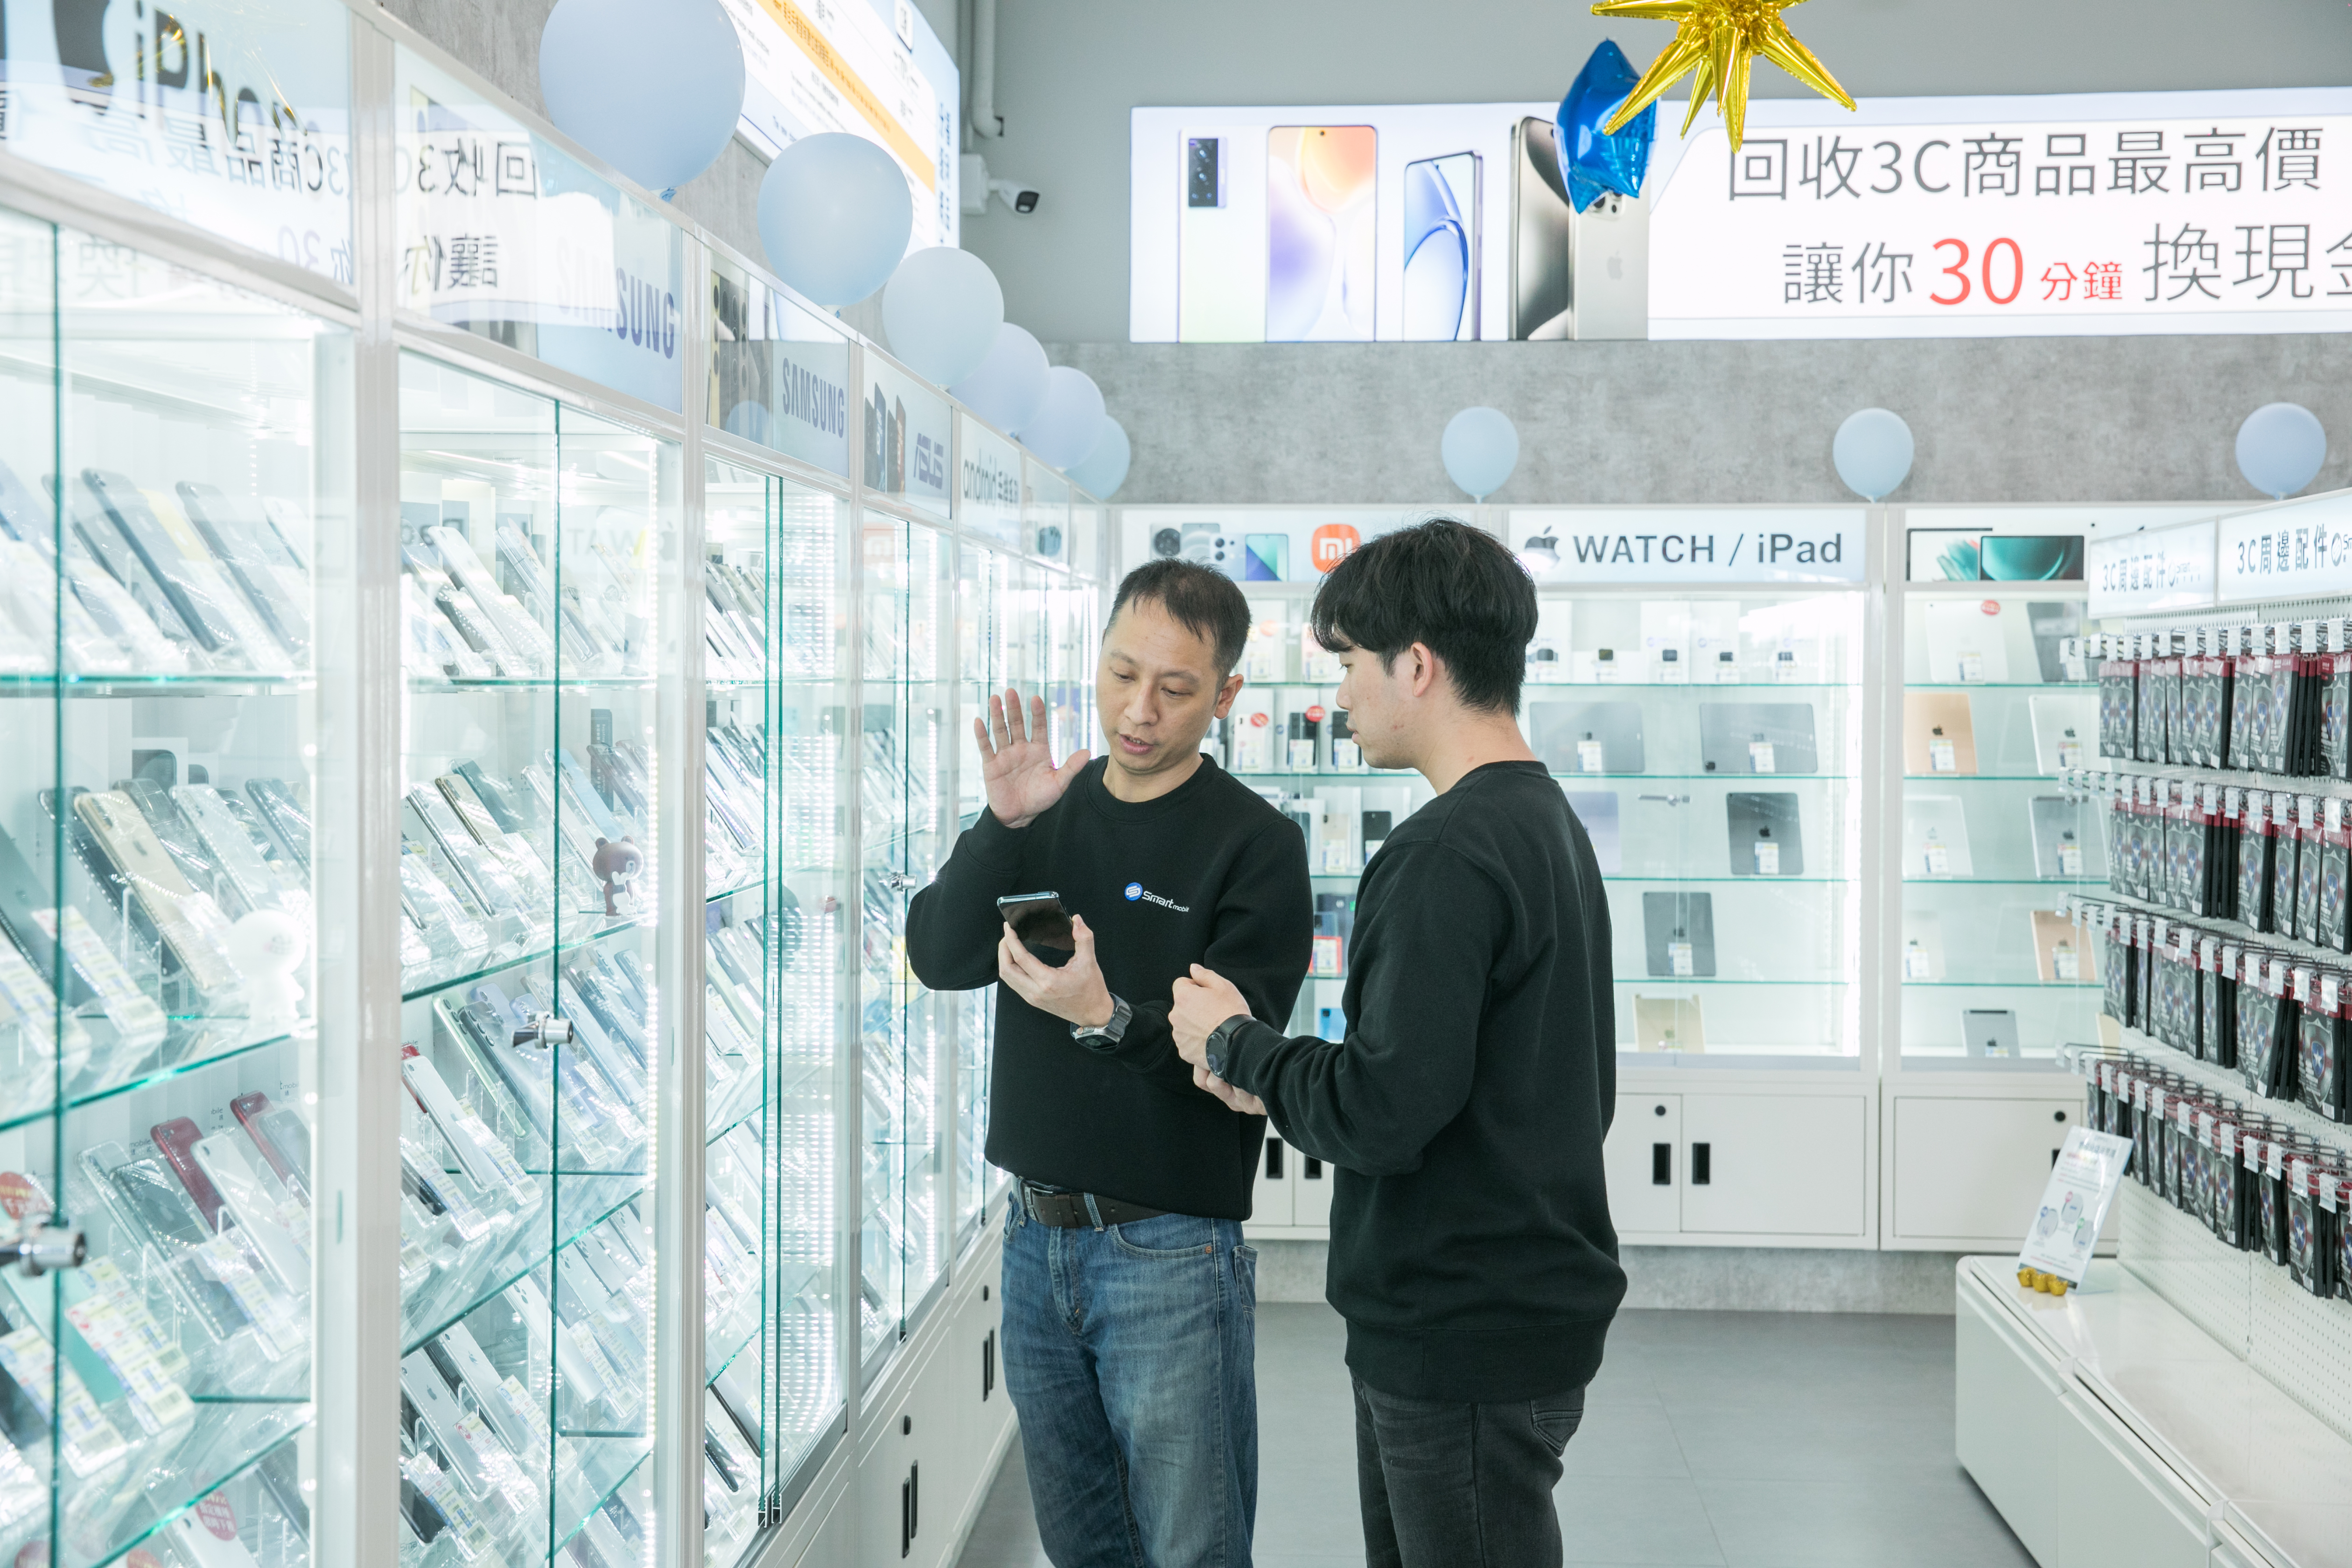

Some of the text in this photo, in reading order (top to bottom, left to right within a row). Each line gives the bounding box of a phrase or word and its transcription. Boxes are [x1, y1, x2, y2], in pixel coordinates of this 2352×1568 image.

[1728, 125, 2323, 201] 回收3C商品最高價
[1930, 237, 2023, 305] 30
[783, 357, 845, 439] SAMSUNG
[913, 432, 944, 490] ASUS
[1574, 535, 1714, 564] WATCH
[1757, 533, 1842, 563] iPad
[2237, 524, 2327, 574] 3C周邊配件
[1142, 890, 1174, 908] Smart
